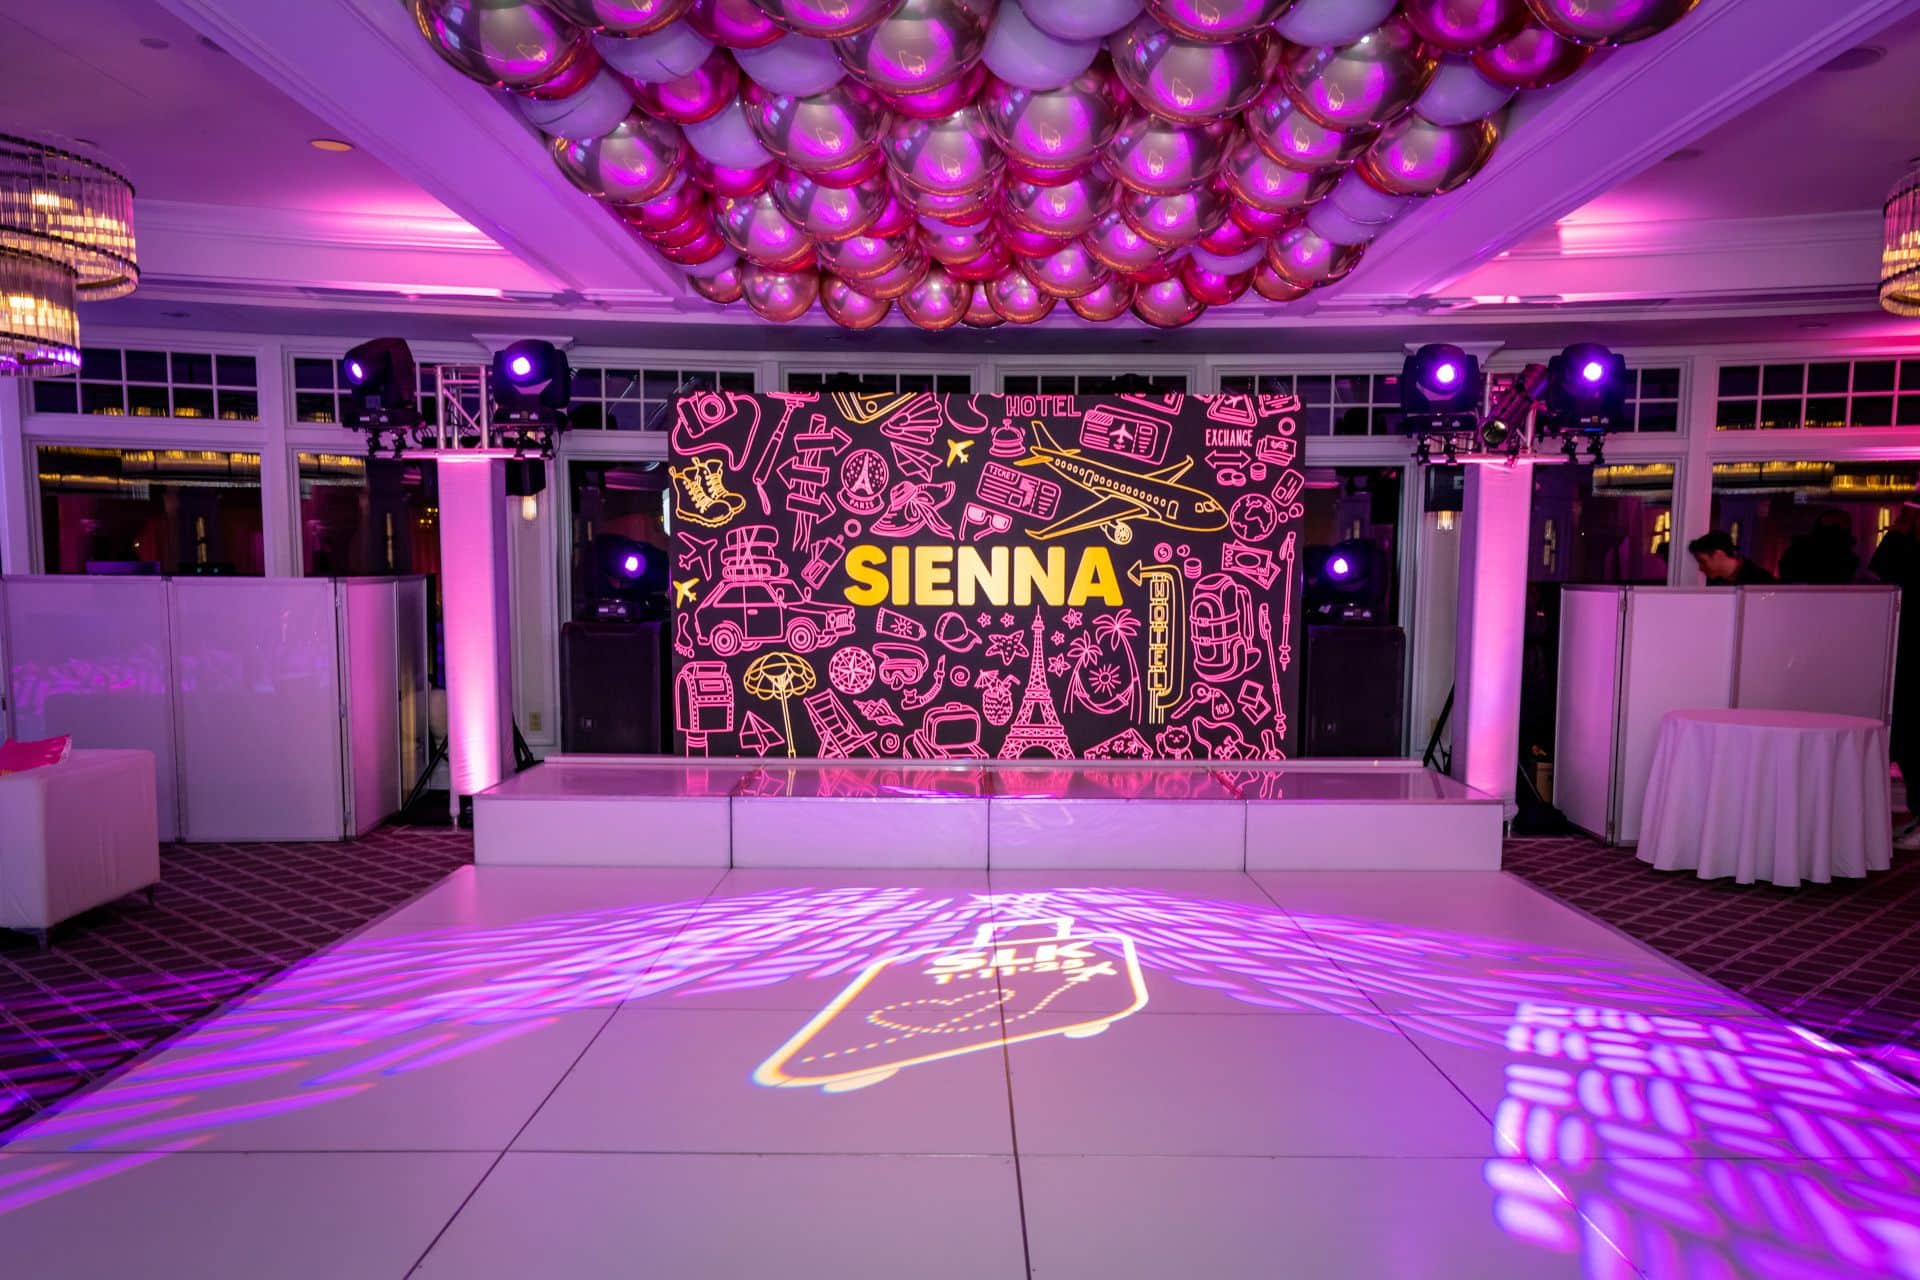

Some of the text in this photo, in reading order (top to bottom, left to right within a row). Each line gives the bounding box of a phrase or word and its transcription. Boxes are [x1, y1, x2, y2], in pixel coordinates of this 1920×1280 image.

[1006, 395, 1081, 416] HOTEL
[1205, 429, 1253, 447] EXCHANGE
[989, 465, 1016, 481] TICKET
[850, 499, 875, 509] PARIS
[1224, 549, 1233, 567] 100
[843, 544, 1124, 606] SIENNA
[922, 941, 1096, 974] SLK
